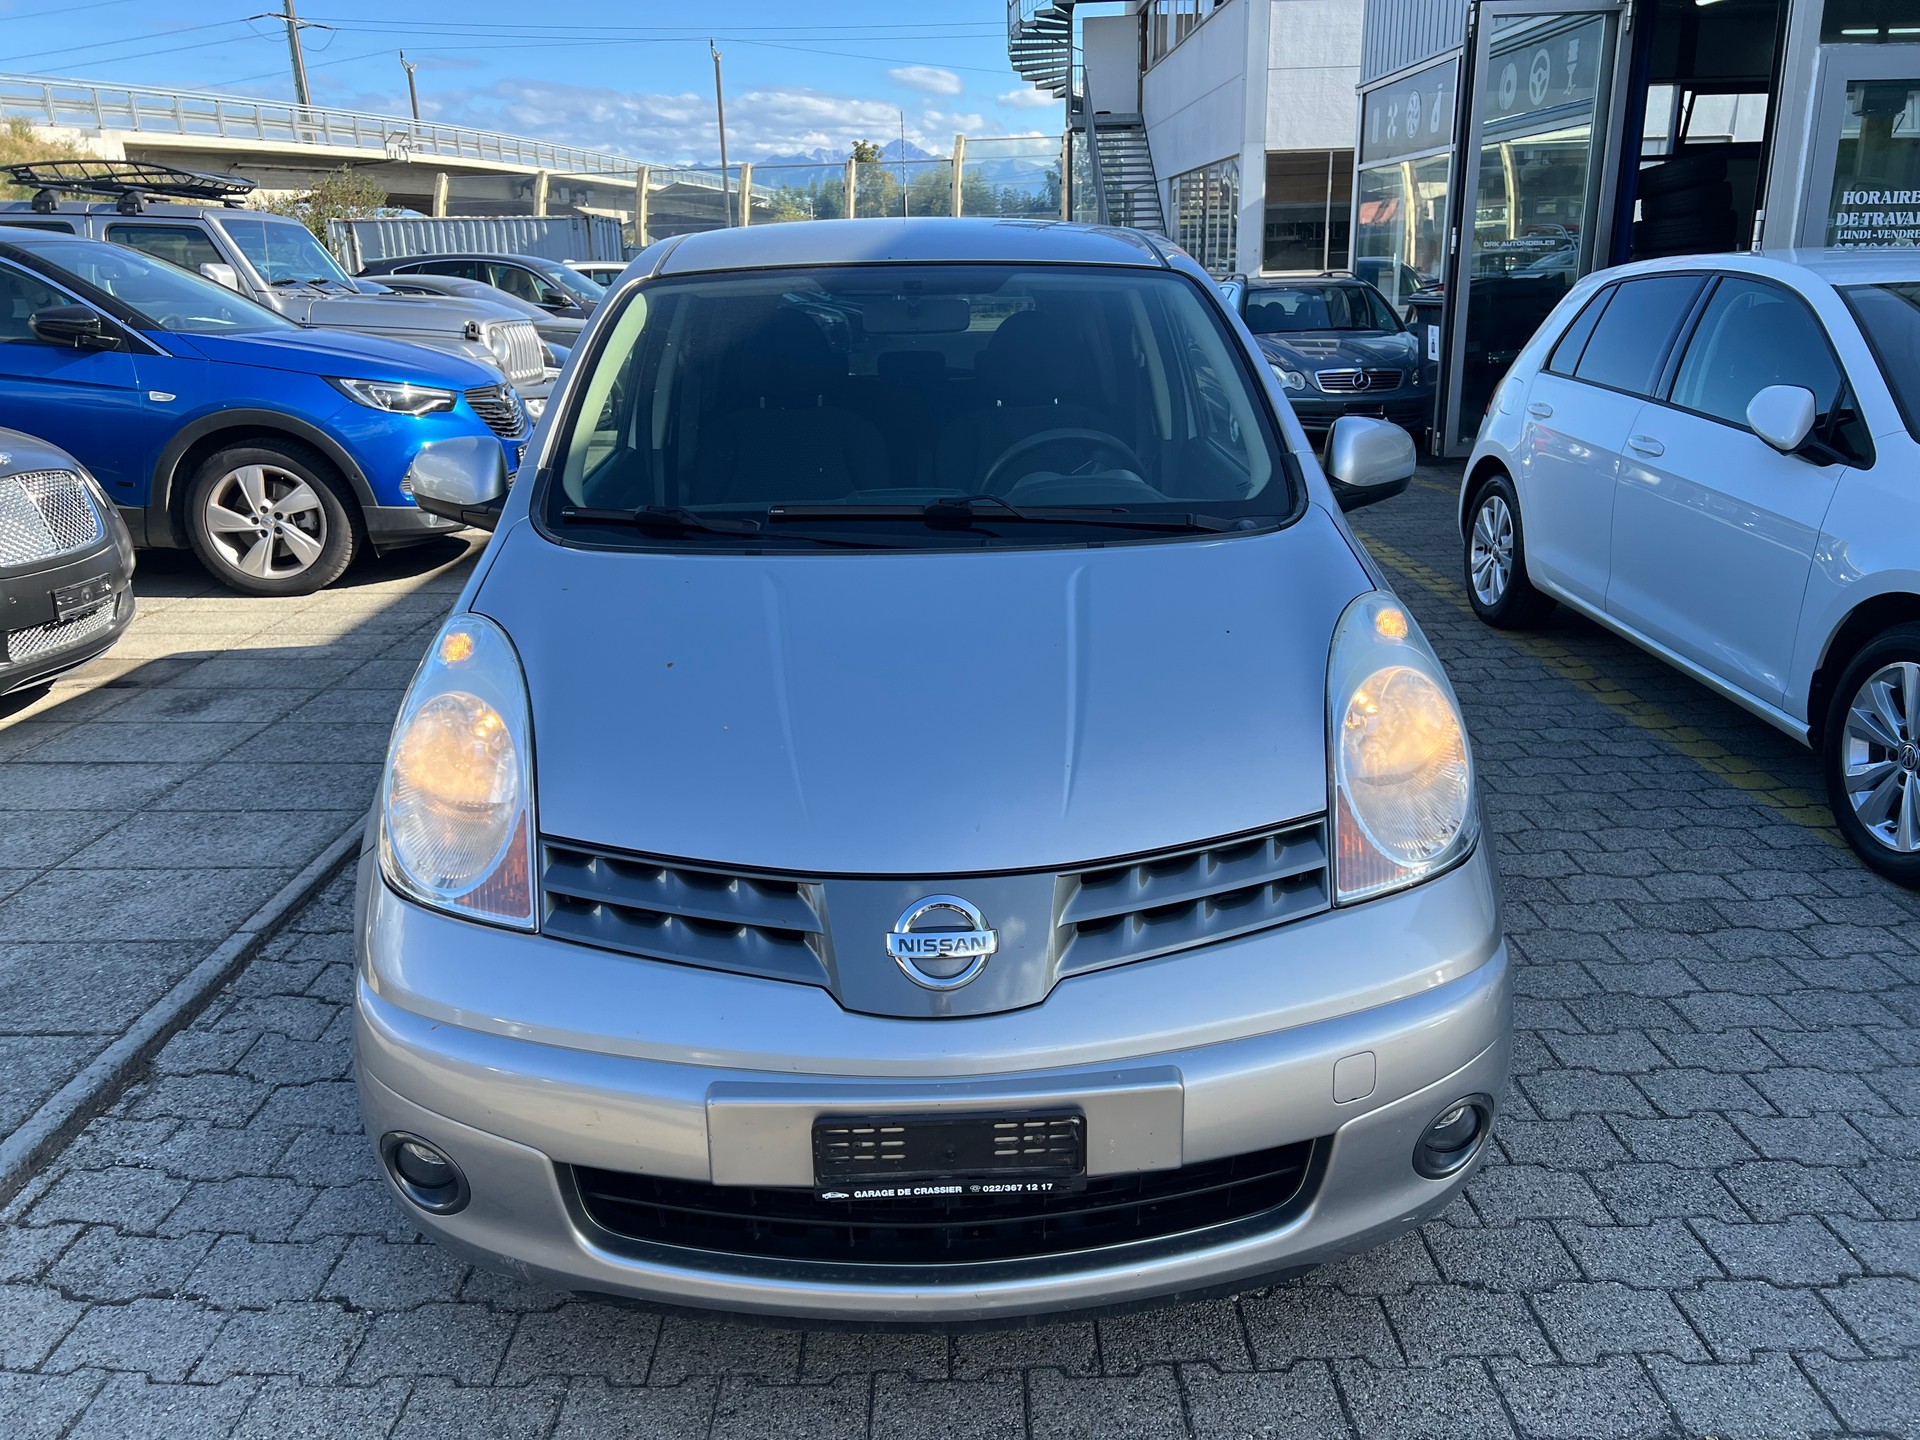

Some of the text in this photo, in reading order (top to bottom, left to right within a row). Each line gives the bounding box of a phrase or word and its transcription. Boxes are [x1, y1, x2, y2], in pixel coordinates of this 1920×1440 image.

[1835, 212, 1859, 226] DE
[1501, 239, 1555, 247] AUTOMOBILES
[898, 936, 986, 952] NISSAN
[854, 1183, 1053, 1198] GARAGE DE CRASSIER 022/367 12 17
